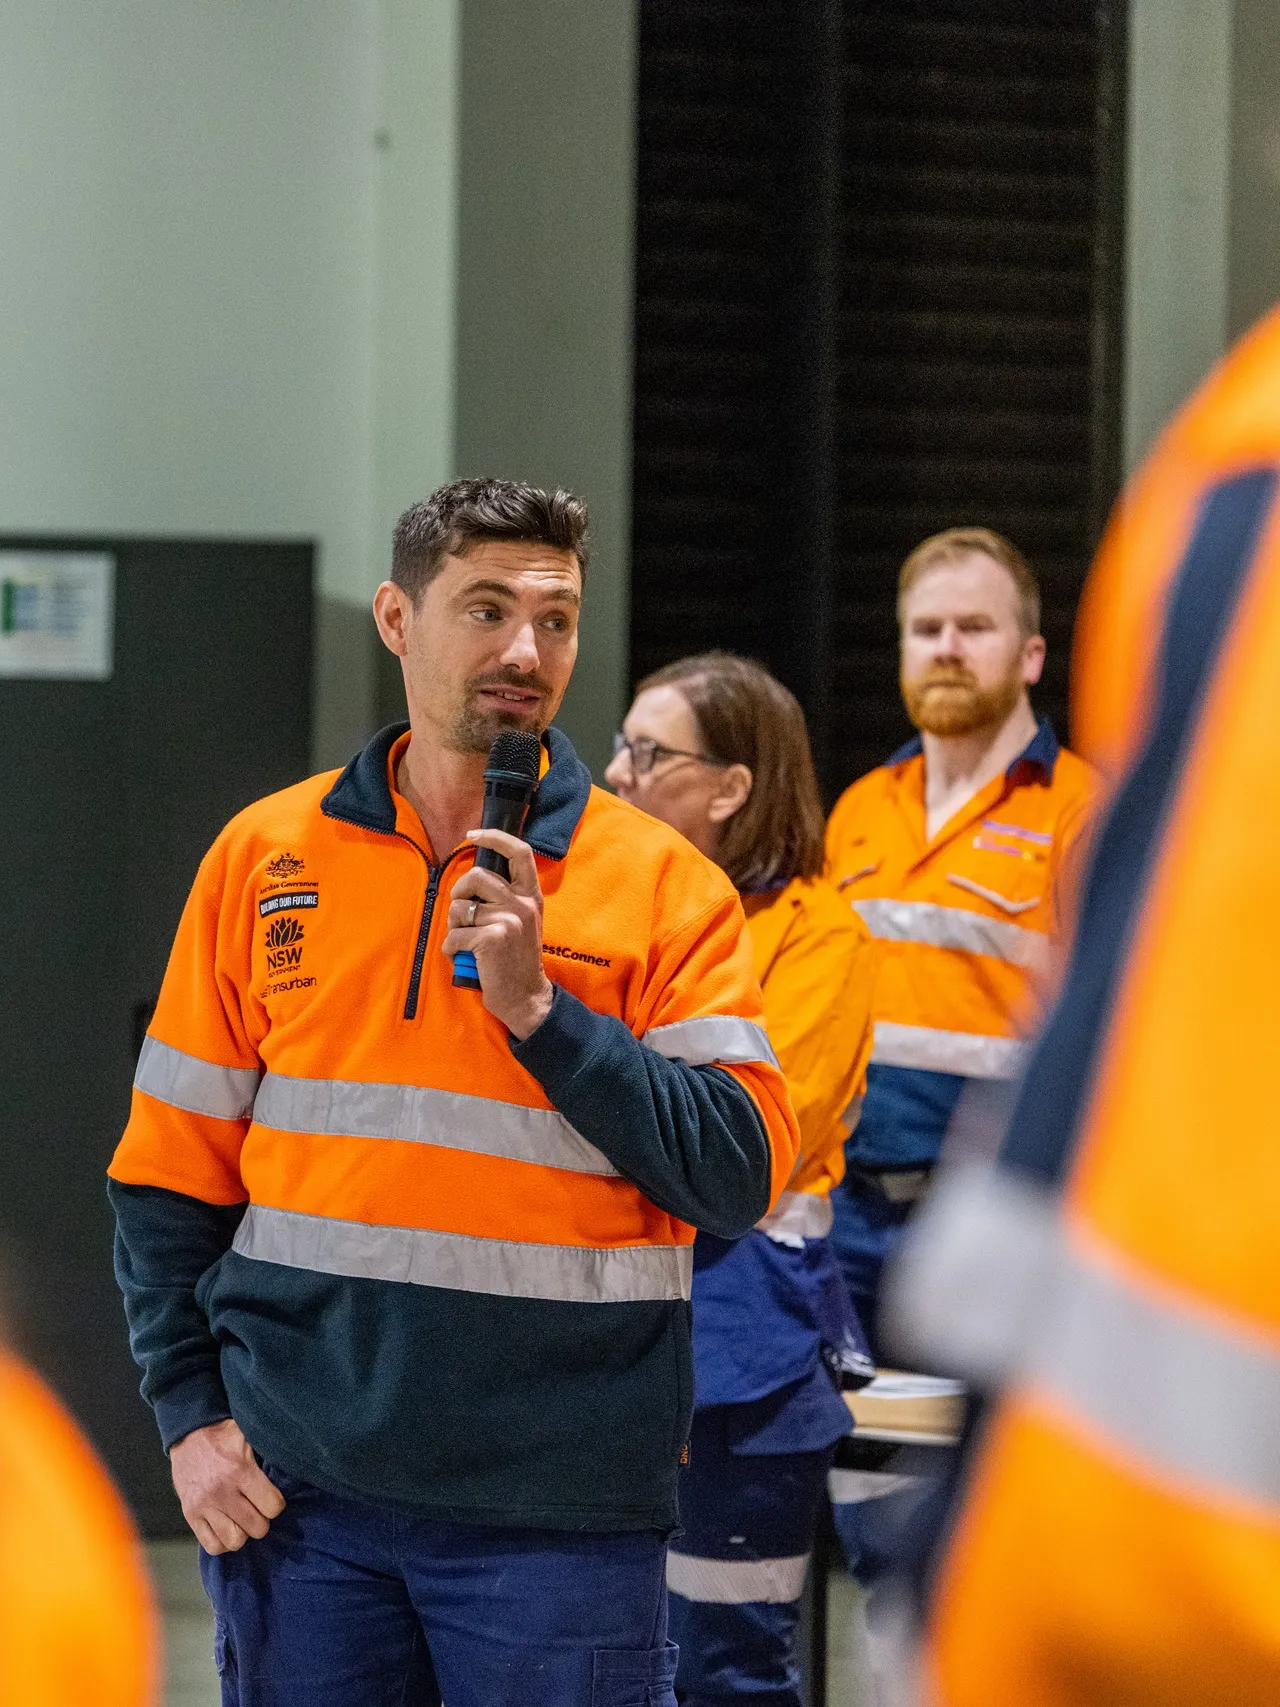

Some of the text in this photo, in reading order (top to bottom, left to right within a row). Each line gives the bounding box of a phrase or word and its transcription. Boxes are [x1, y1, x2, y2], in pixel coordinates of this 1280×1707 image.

[279, 896, 292, 908] OUR
[292, 895, 318, 906] FUTURE
[267, 947, 303, 971] NSW
[542, 944, 611, 968] estConnex
